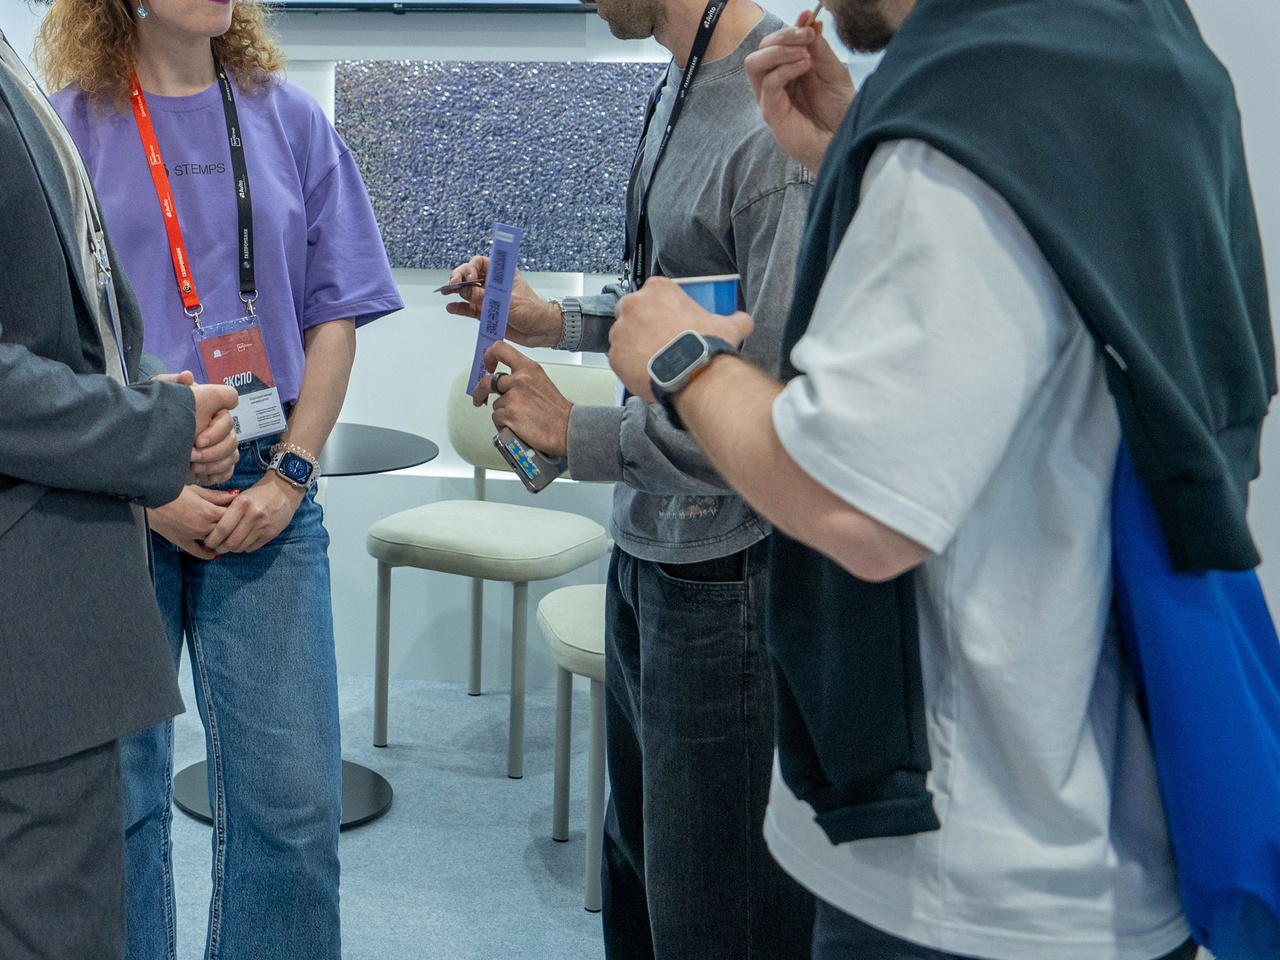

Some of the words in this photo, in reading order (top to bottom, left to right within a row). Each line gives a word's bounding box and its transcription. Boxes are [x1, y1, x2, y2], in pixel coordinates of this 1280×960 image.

[704, 5, 717, 23] Avito
[174, 162, 226, 176] STEMPS
[223, 371, 252, 388] ЭКСПО
